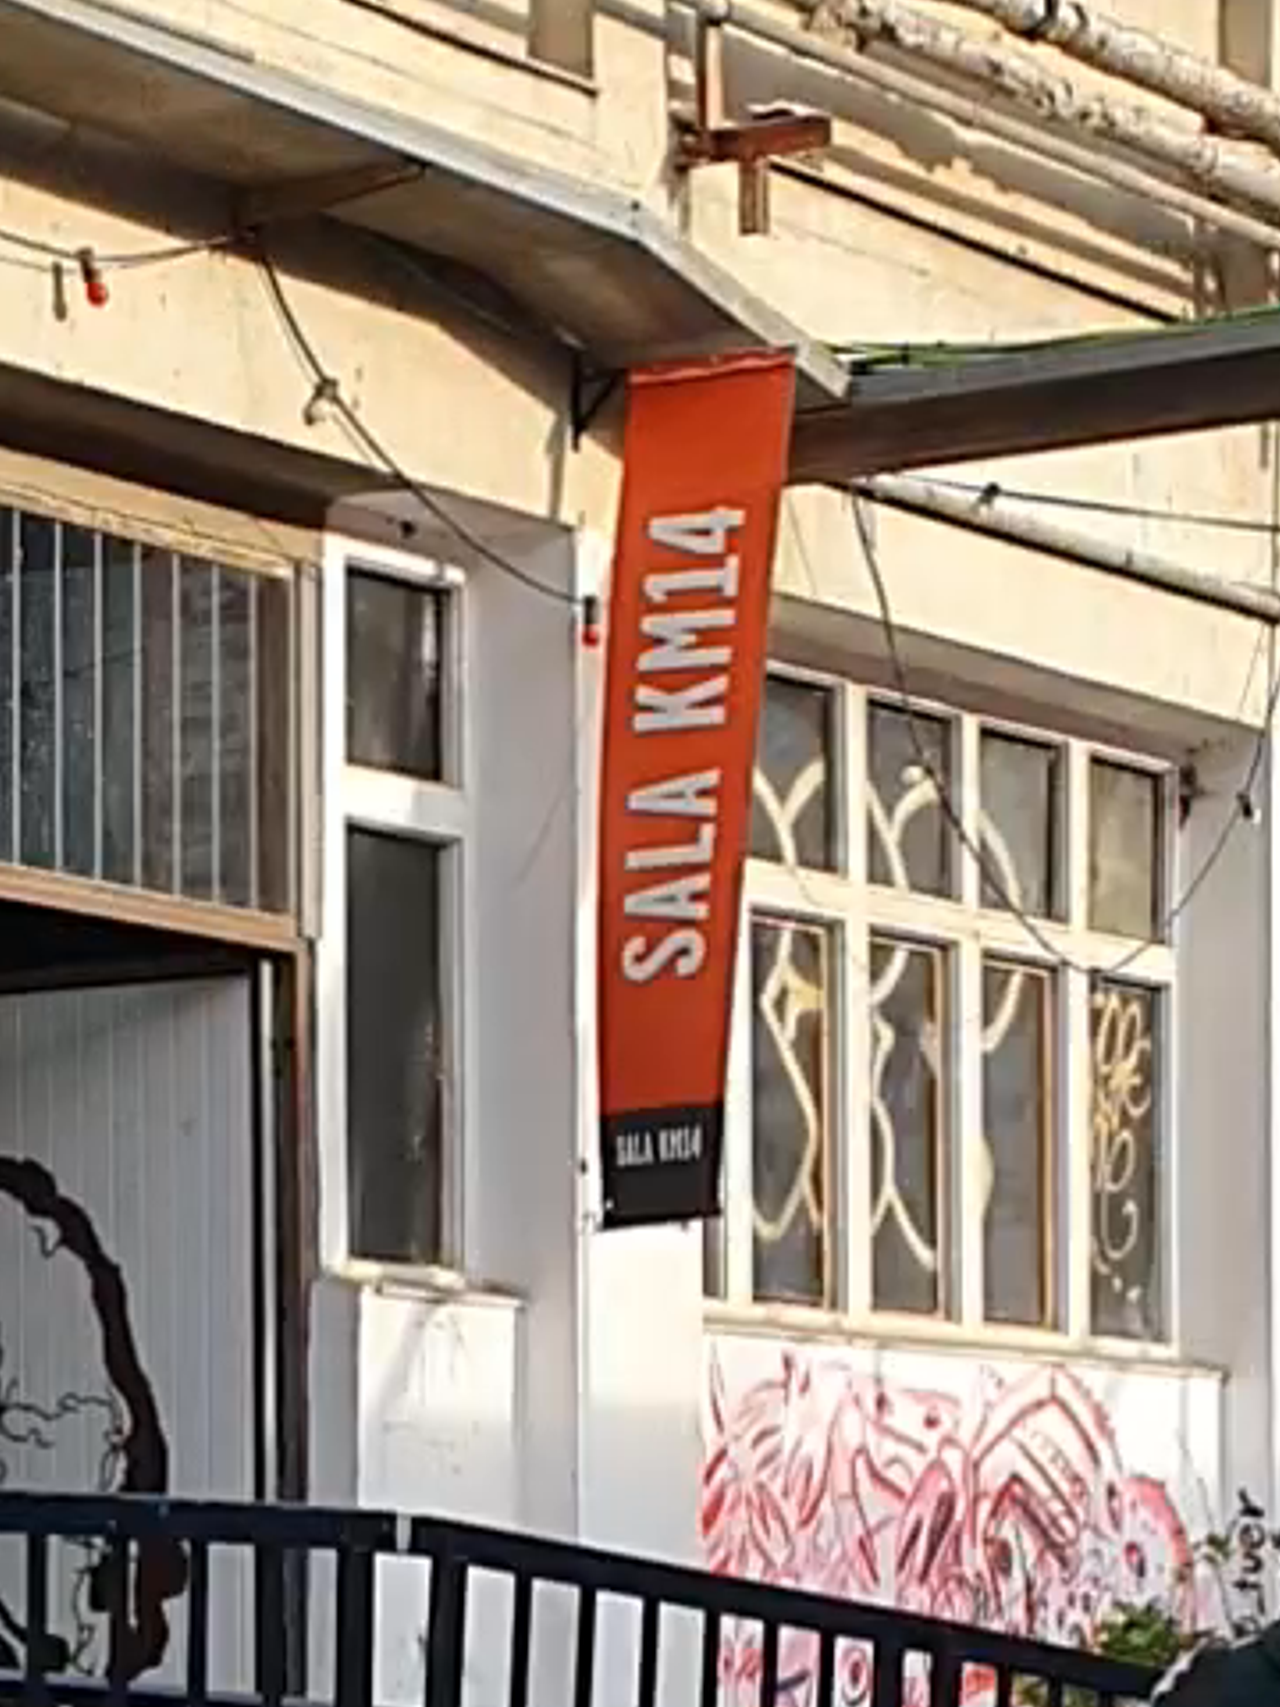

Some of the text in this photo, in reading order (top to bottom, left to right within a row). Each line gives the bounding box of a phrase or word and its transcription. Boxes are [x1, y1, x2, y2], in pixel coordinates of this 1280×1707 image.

[622, 505, 747, 983] SALA KM14
[616, 1123, 702, 1167] SALA KM14
